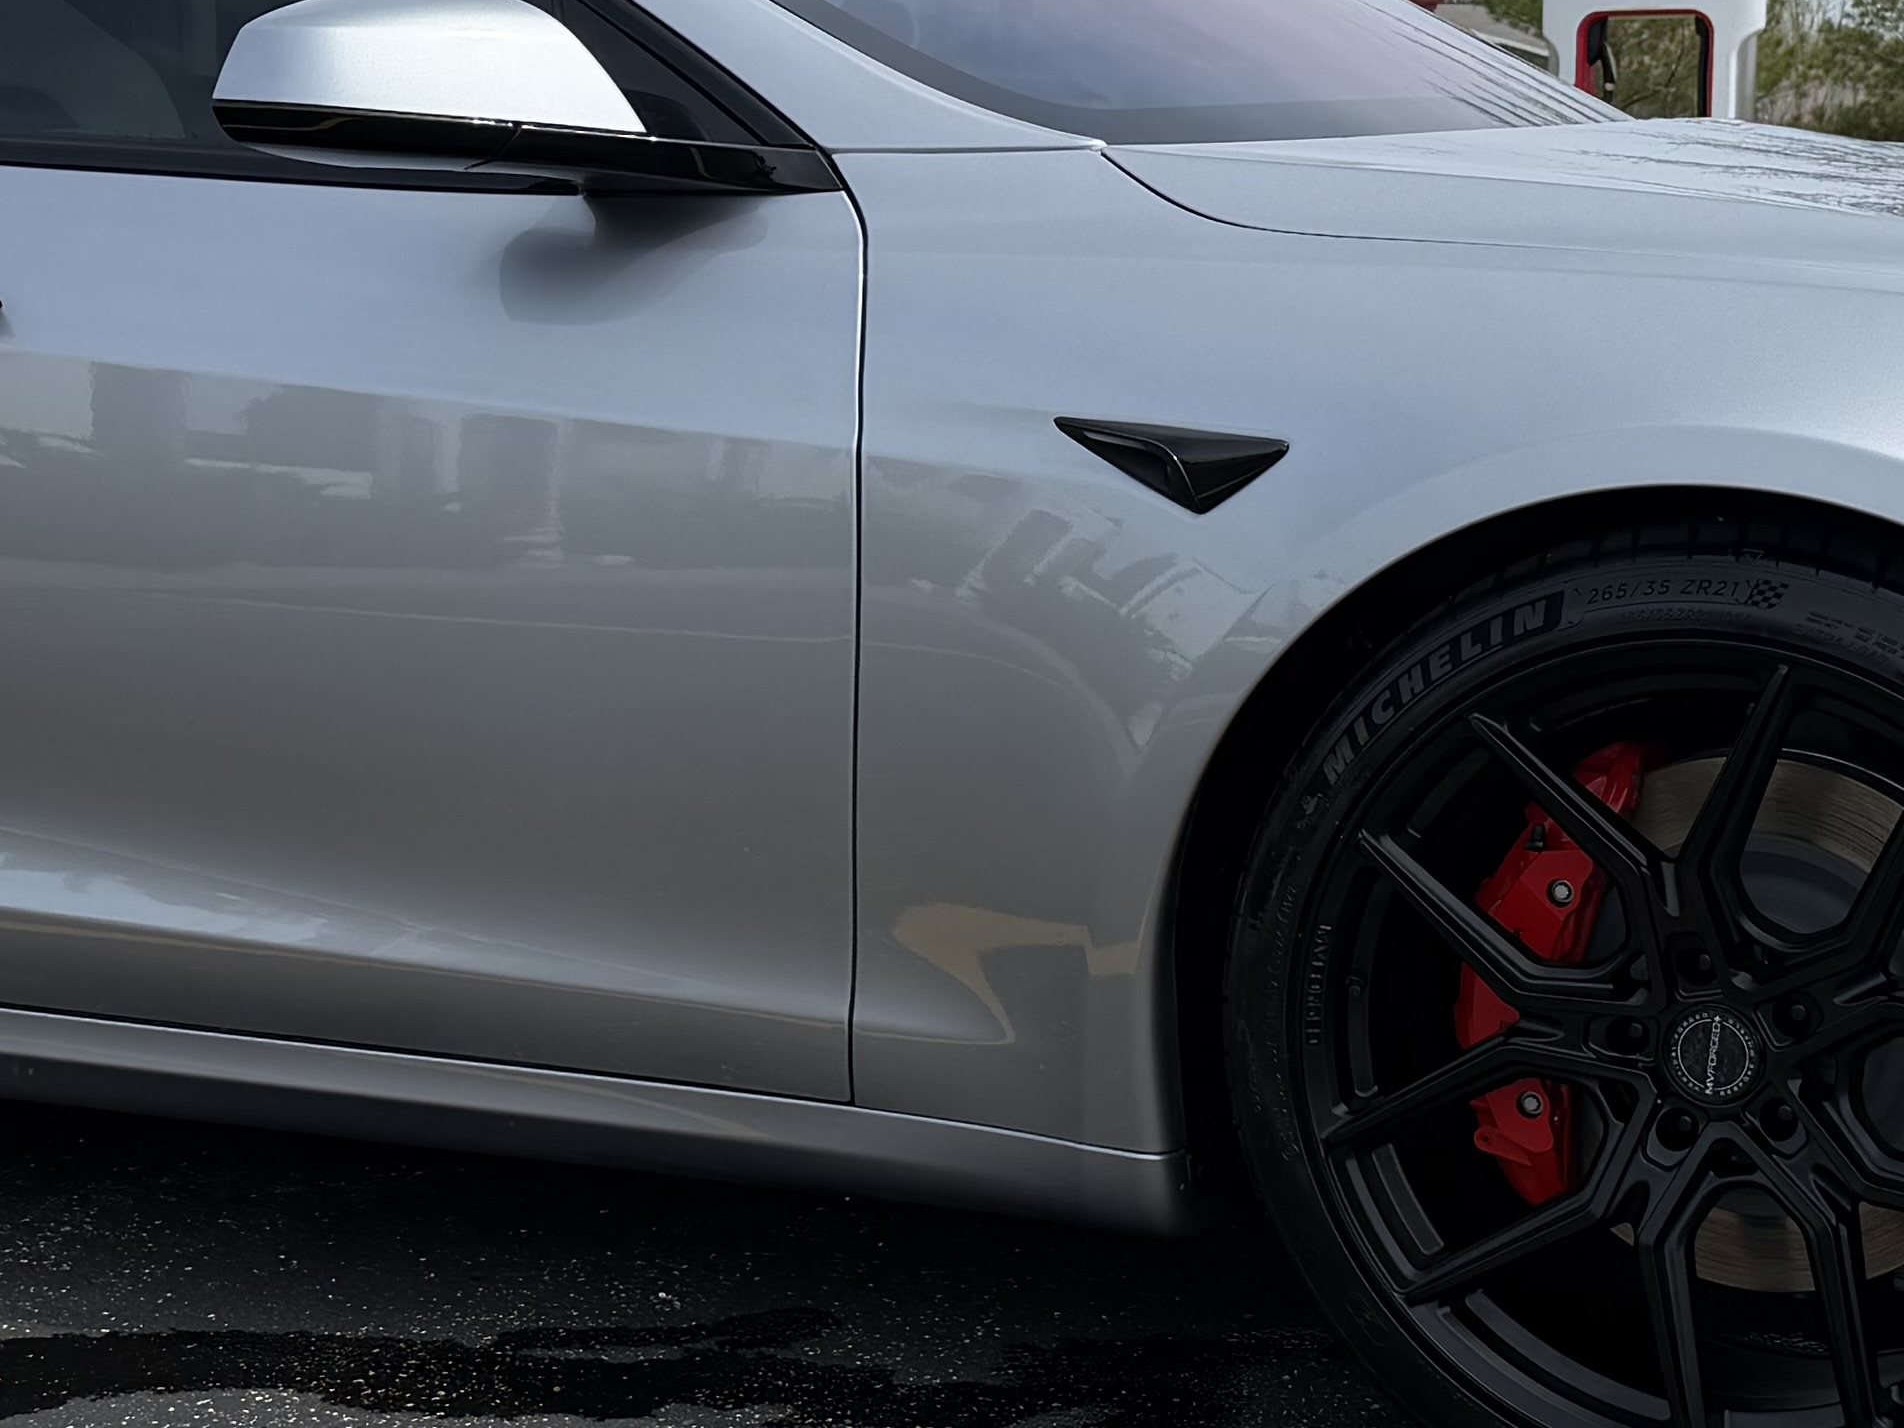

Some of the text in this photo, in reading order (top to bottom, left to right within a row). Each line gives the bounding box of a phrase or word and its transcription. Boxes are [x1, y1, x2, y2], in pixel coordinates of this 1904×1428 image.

[1587, 579, 1740, 605] 265/35 ZR21
[1322, 598, 1547, 786] MICHELIN
